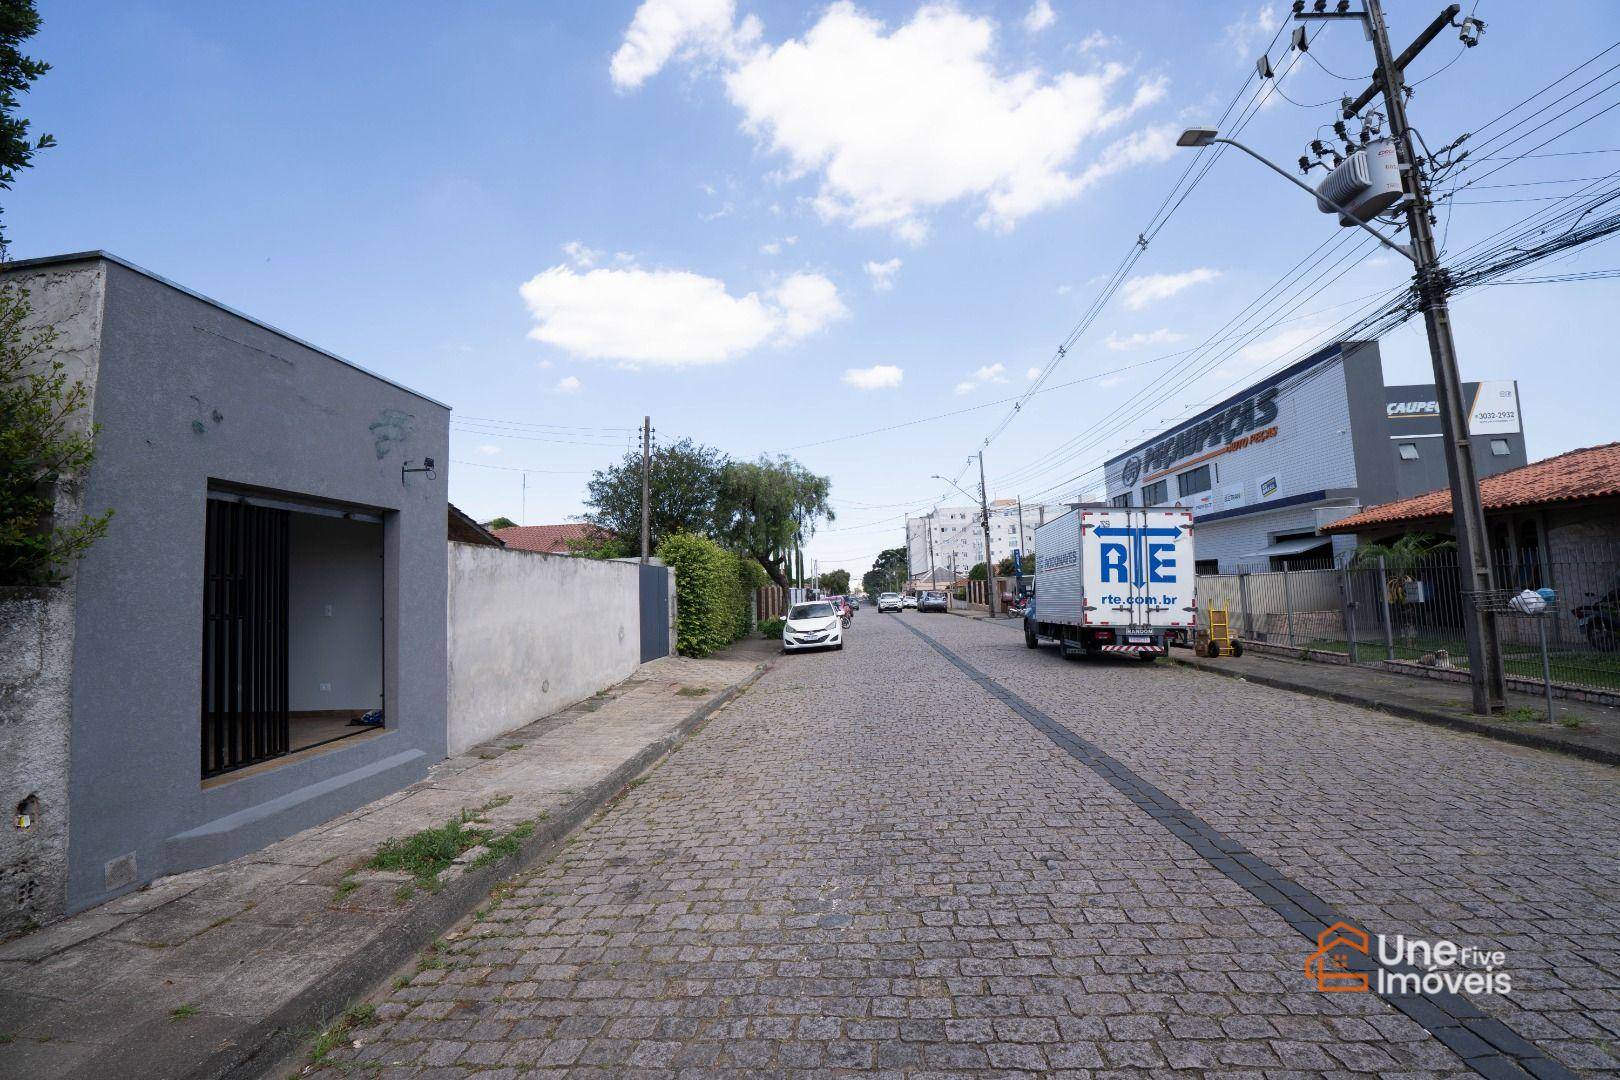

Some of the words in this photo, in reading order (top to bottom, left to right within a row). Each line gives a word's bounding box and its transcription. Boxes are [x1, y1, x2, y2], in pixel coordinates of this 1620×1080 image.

[1478, 411, 1515, 420] 3032-2932
[1227, 438, 1249, 453] AUTO
[1101, 594, 1178, 606] rte.com.br
